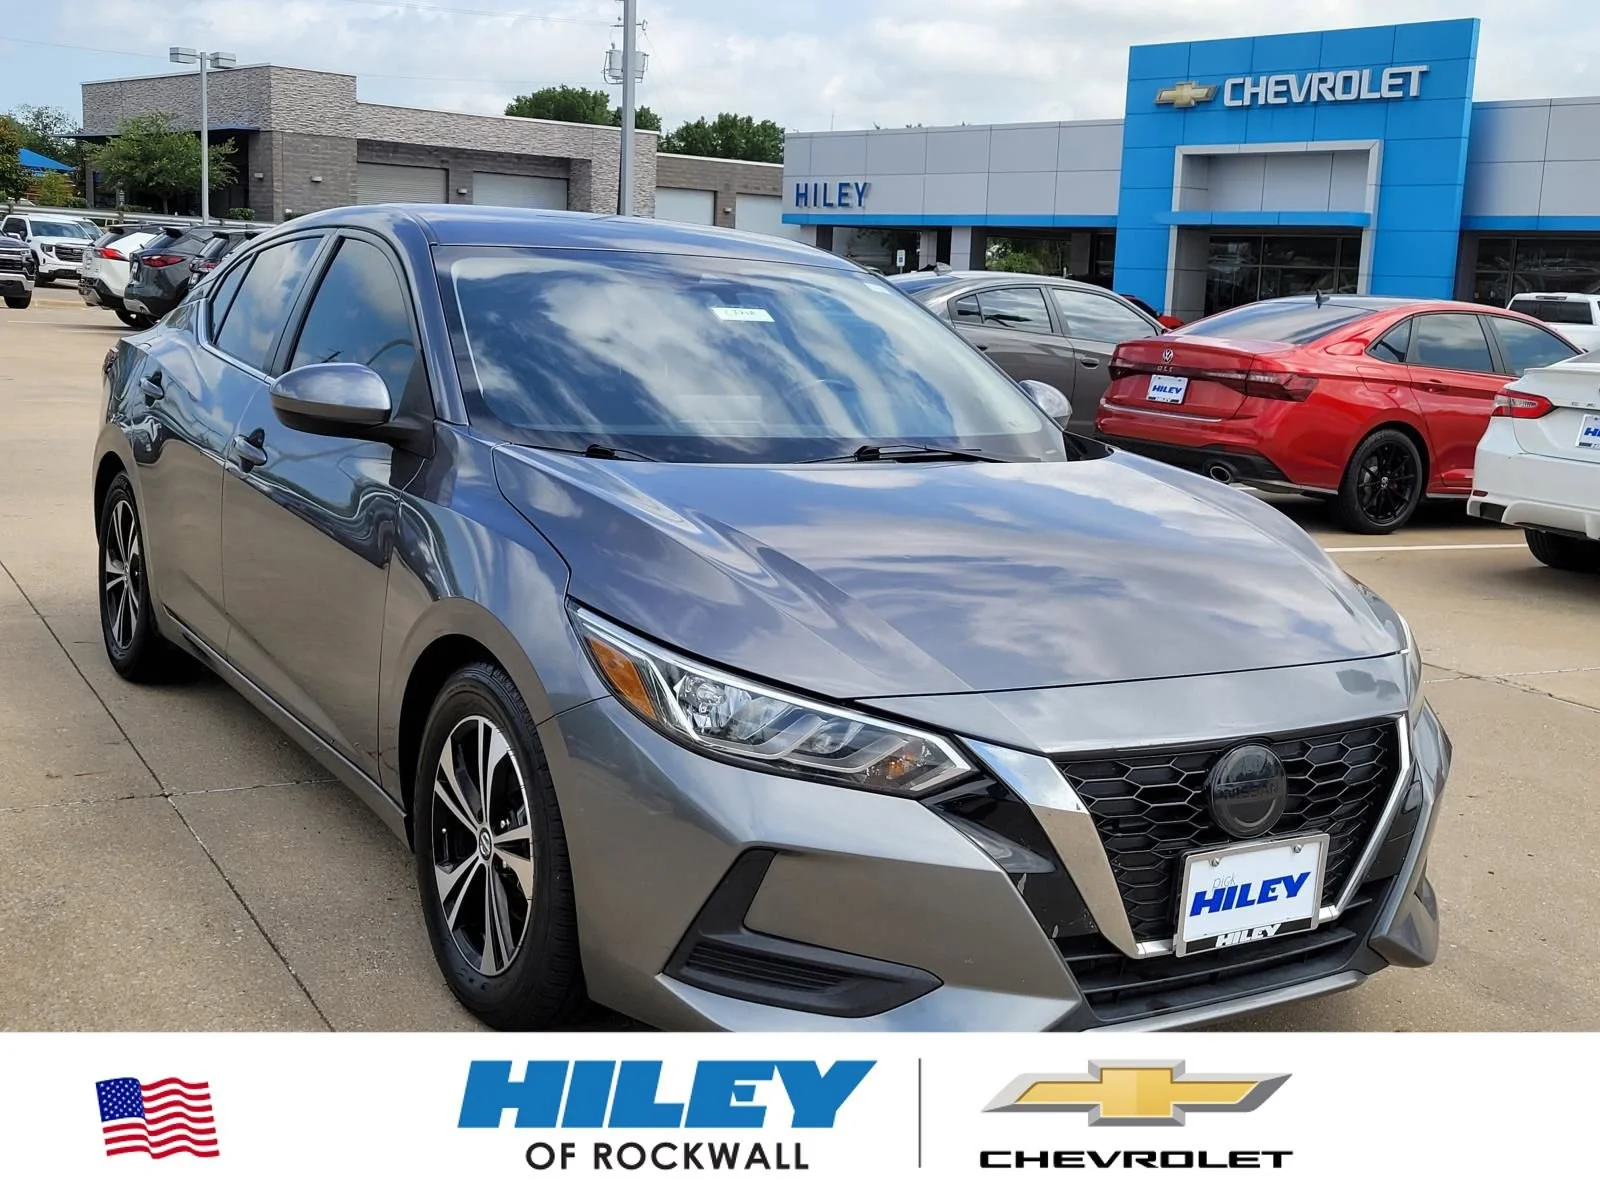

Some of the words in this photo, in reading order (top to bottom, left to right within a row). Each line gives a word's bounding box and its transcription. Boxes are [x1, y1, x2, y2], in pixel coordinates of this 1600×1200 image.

[1223, 65, 1429, 107] CHEVROLET
[795, 182, 870, 208] HILEY
[1189, 871, 1311, 917] HILEY
[1215, 923, 1282, 948] HILEY
